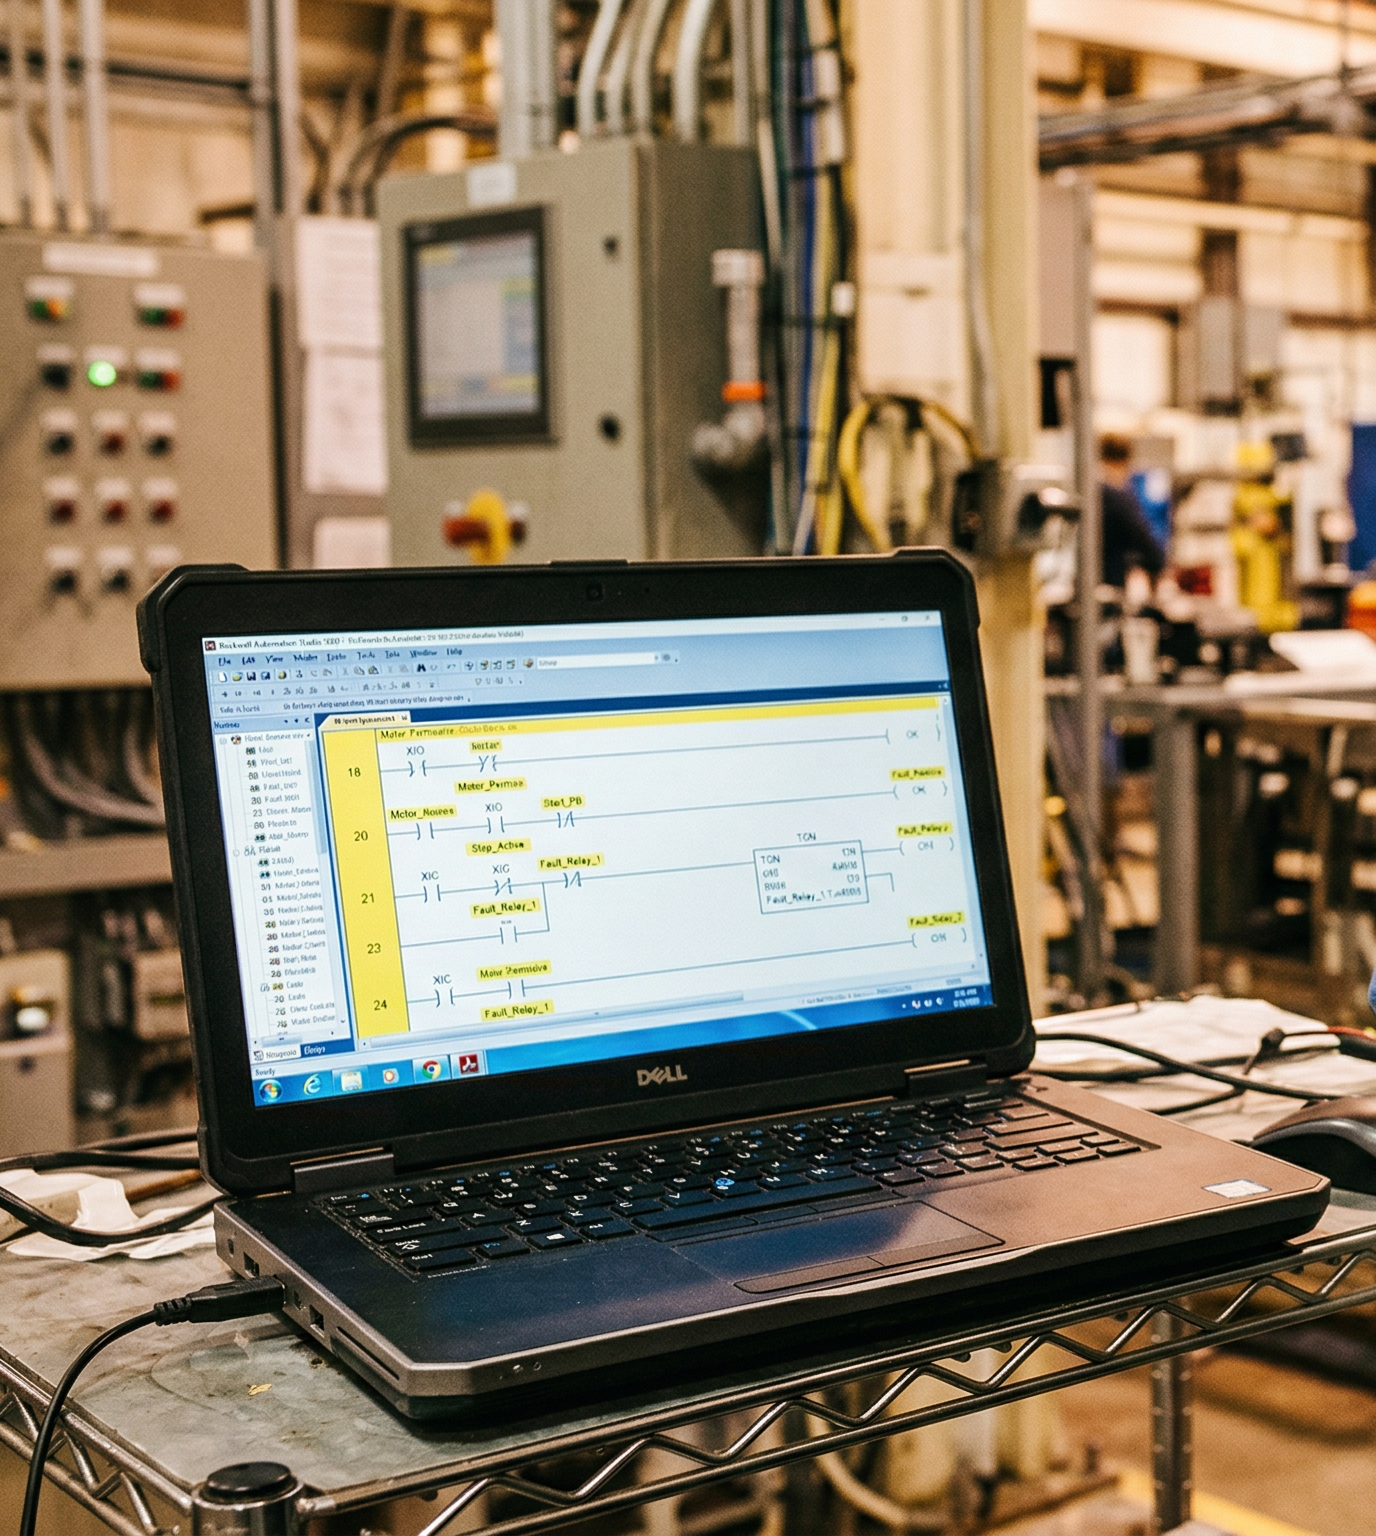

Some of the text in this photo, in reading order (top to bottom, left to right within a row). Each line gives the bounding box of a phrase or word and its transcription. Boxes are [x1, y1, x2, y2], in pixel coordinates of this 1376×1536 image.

[406, 746, 425, 756] XIO
[347, 766, 362, 778] 18
[354, 830, 369, 842] 20
[361, 893, 376, 904] 21
[367, 943, 382, 954] 23
[373, 1000, 388, 1011] 24
[636, 1064, 689, 1087] DELL
